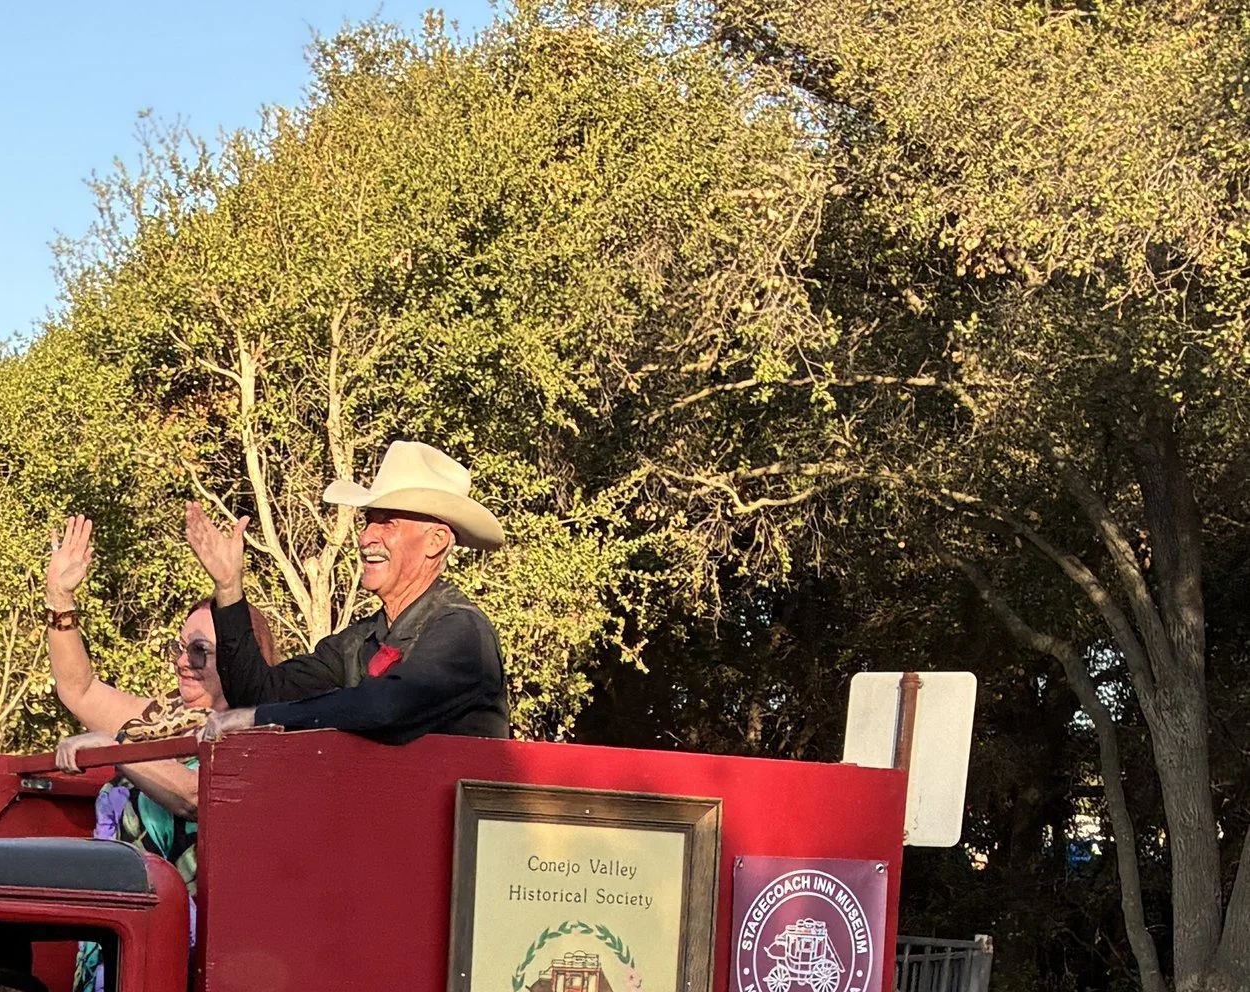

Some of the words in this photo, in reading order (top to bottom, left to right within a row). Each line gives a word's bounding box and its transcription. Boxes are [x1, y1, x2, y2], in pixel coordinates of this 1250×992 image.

[527, 855, 581, 877] Conejo
[589, 859, 637, 880] Valley
[509, 884, 588, 903] Historical
[596, 888, 653, 910] Society
[742, 876, 811, 951] STAGECOACH
[813, 877, 836, 896] INN
[835, 893, 868, 954] MUSEUM
